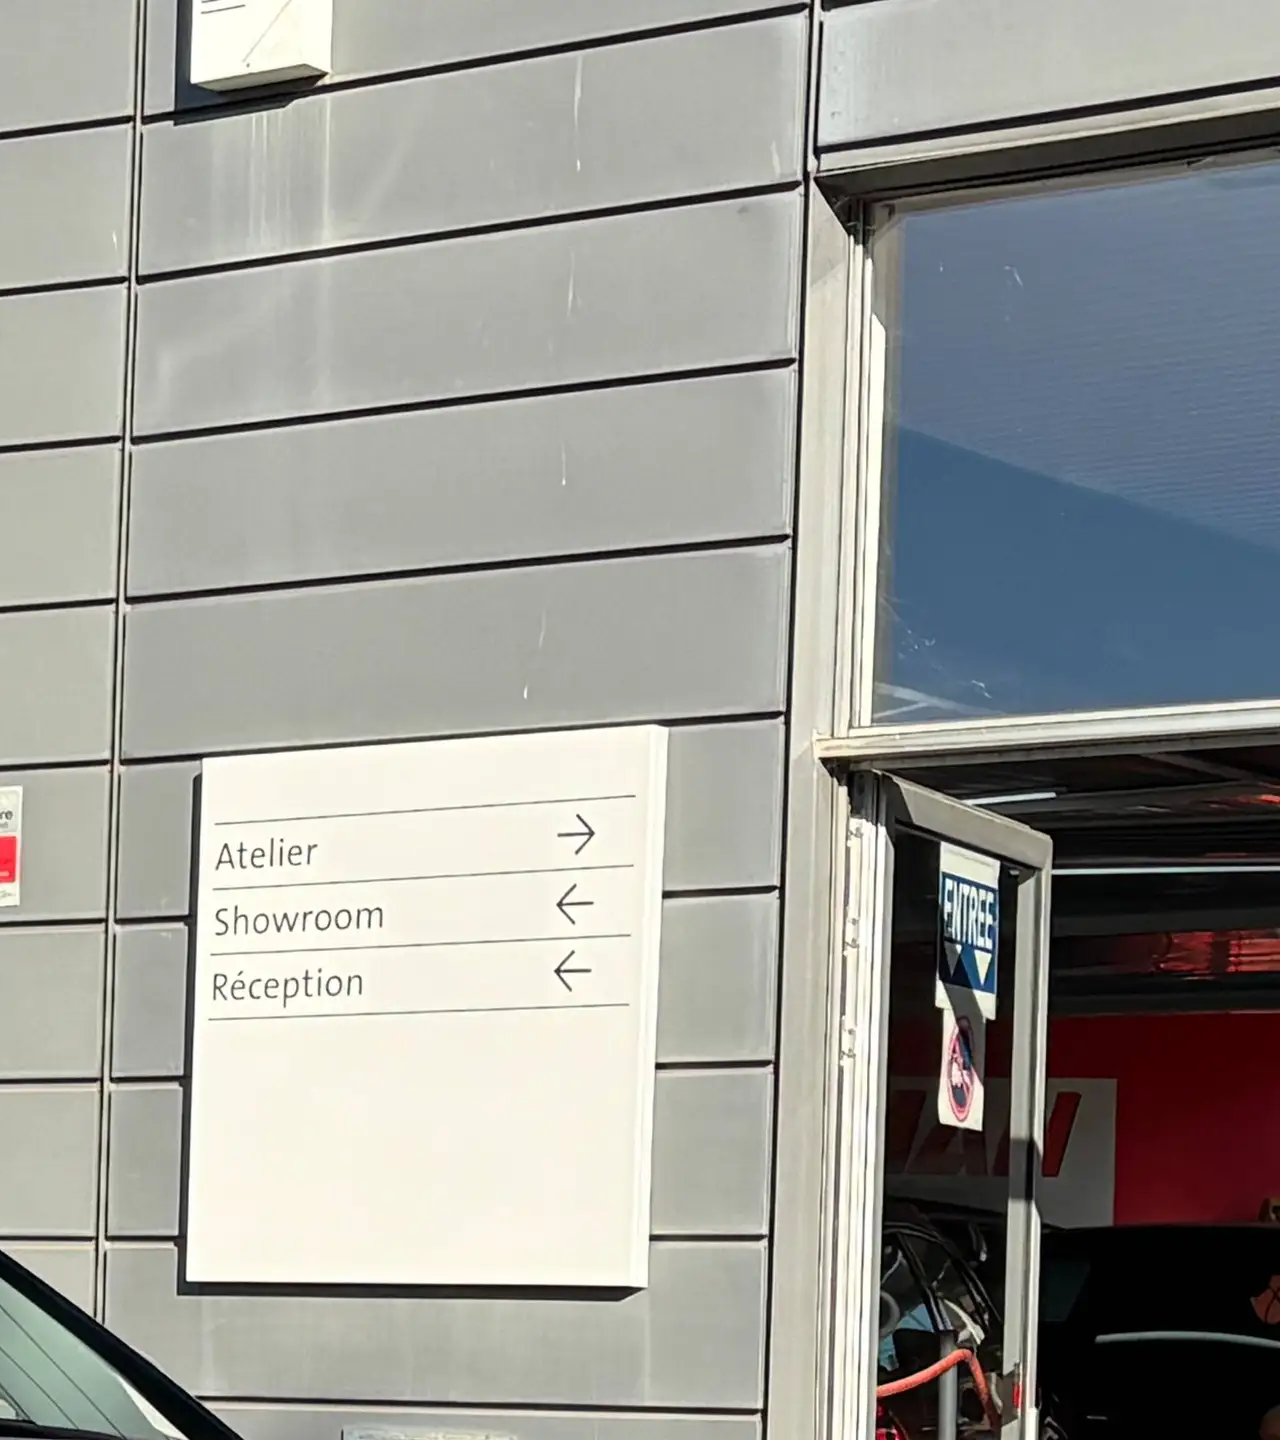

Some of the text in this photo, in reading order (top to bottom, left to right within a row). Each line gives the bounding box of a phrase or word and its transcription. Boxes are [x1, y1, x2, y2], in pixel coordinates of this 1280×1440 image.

[215, 838, 319, 871] Atelier
[214, 904, 384, 937] Showroom
[943, 877, 995, 952] ENTREE
[212, 968, 364, 1008] Réception
